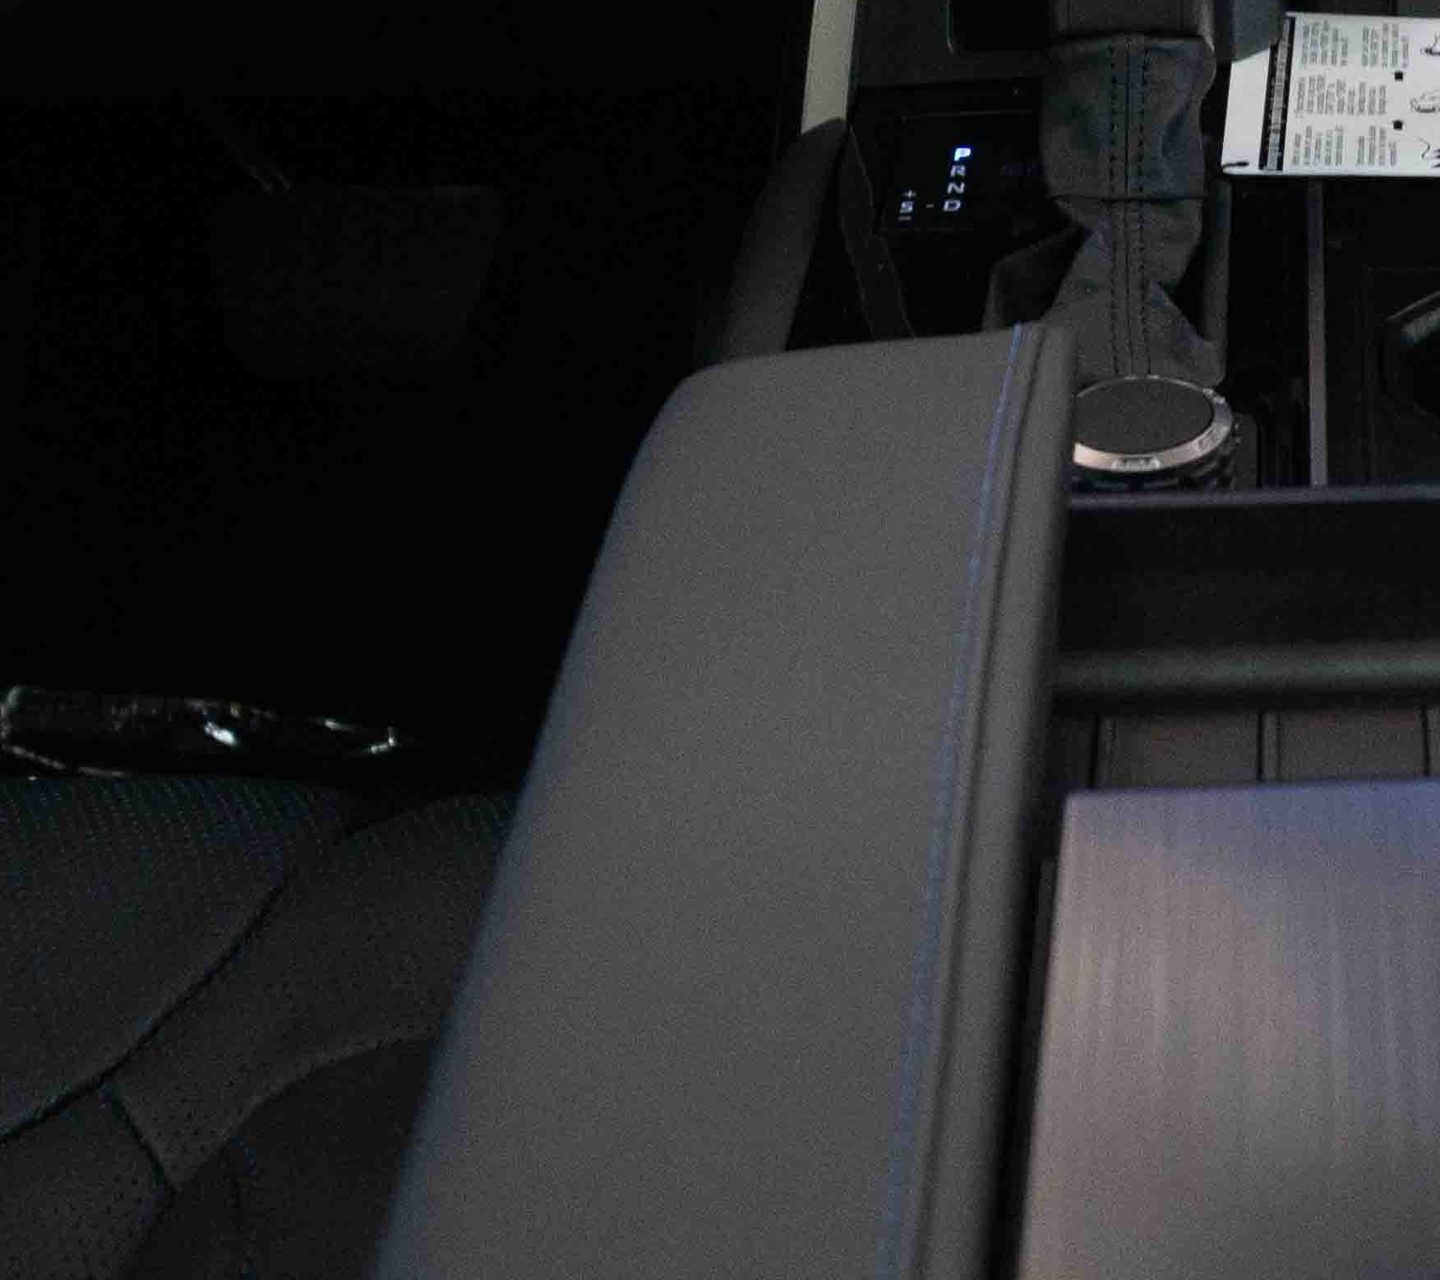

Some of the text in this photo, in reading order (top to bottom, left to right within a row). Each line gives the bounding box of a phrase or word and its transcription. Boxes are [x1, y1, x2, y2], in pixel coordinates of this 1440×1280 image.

[954, 147, 971, 161] P
[950, 165, 966, 177] R
[947, 182, 965, 194] N
[943, 199, 961, 211] D
